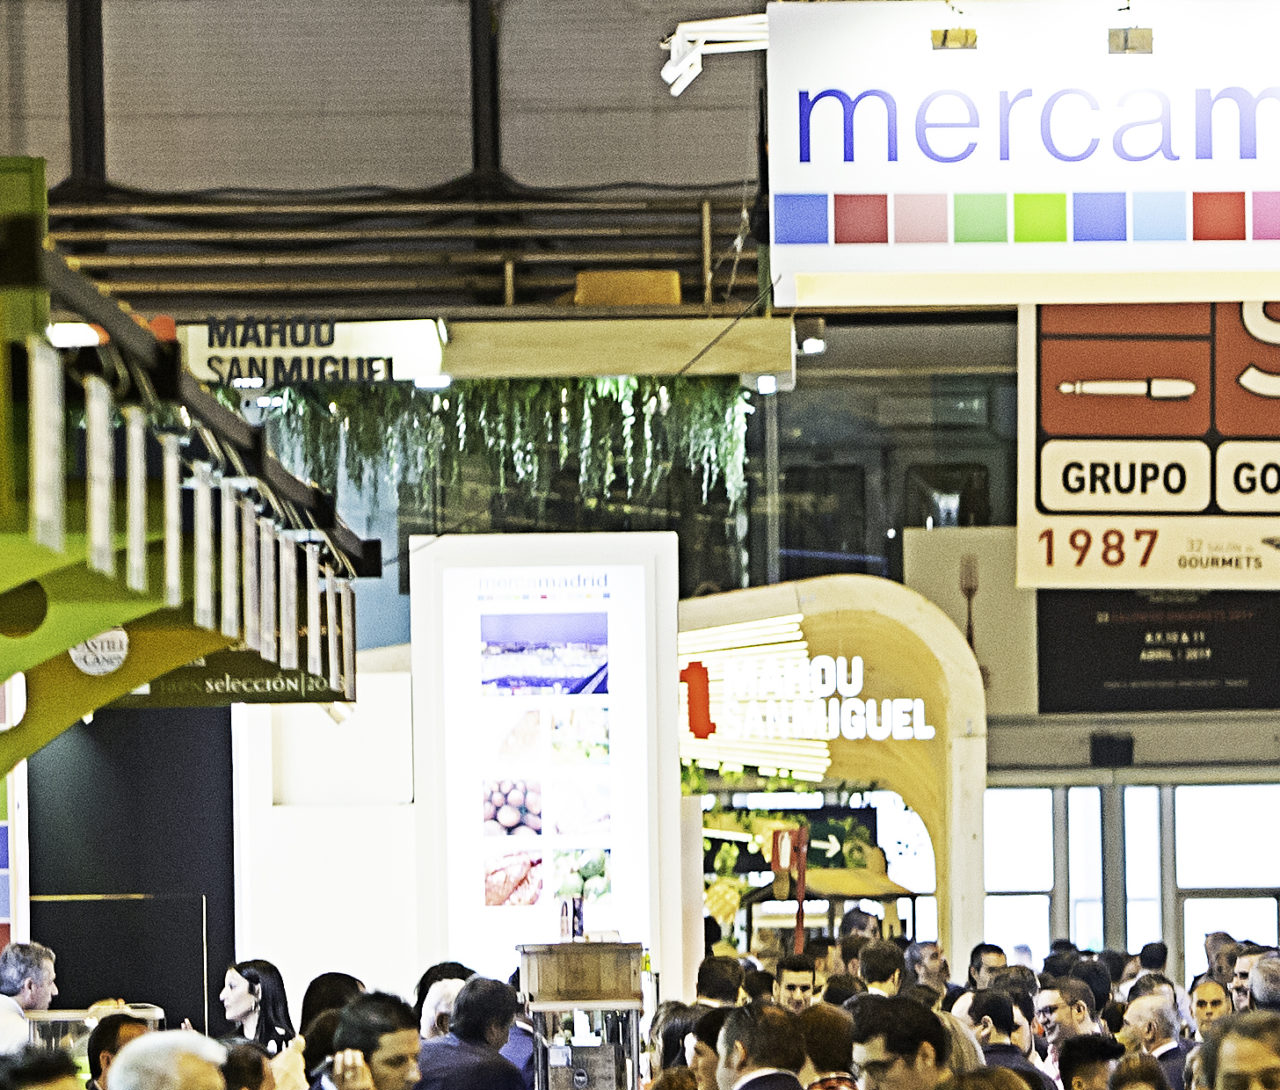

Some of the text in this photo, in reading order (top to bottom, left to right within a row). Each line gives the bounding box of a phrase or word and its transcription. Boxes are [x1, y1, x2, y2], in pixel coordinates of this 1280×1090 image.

[206, 315, 336, 348] MAHOU
[1061, 461, 1188, 495] GRUPO
[1037, 527, 1160, 568] 1987
[1178, 555, 1262, 569] GOURMETS
